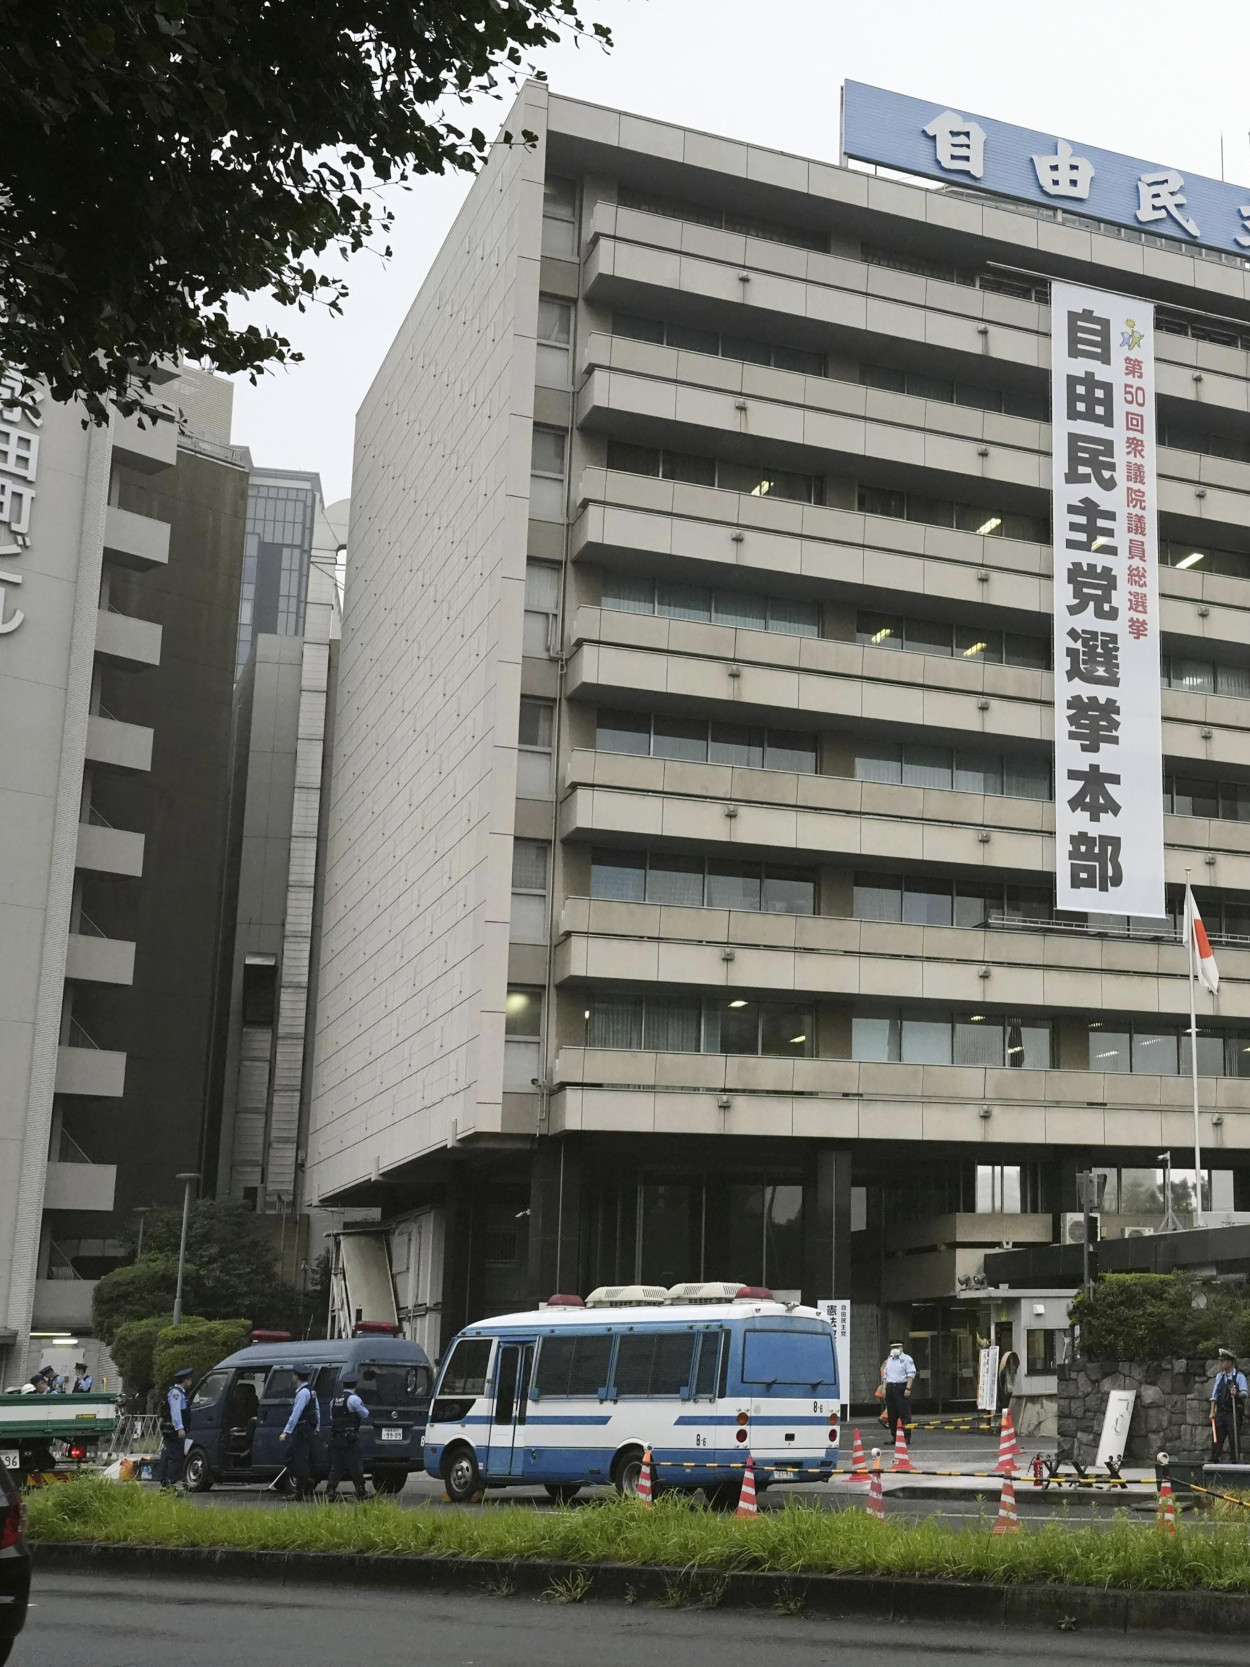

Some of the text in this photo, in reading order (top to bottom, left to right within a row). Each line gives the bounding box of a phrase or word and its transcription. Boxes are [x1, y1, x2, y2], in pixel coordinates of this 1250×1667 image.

[1064, 308, 1123, 892] 自由民主党選挙本部
[1123, 356, 1149, 640] 第50回衆議院議員総選挙
